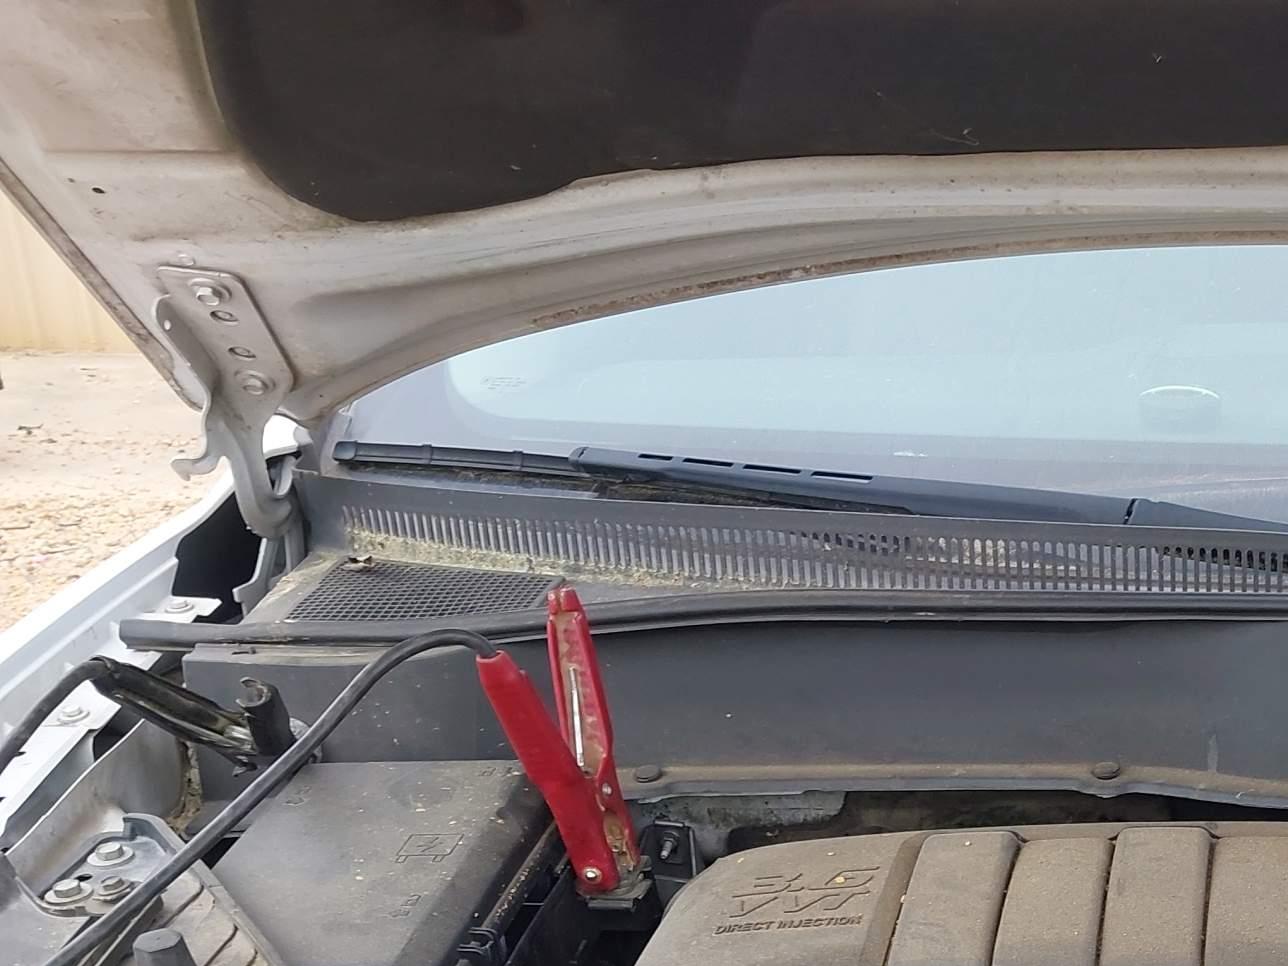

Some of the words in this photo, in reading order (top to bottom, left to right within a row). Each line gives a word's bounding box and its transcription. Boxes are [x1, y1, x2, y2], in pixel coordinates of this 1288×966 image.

[729, 891, 871, 918] VVT
[714, 921, 774, 935] DIRECT
[776, 915, 863, 929] INJECTION
